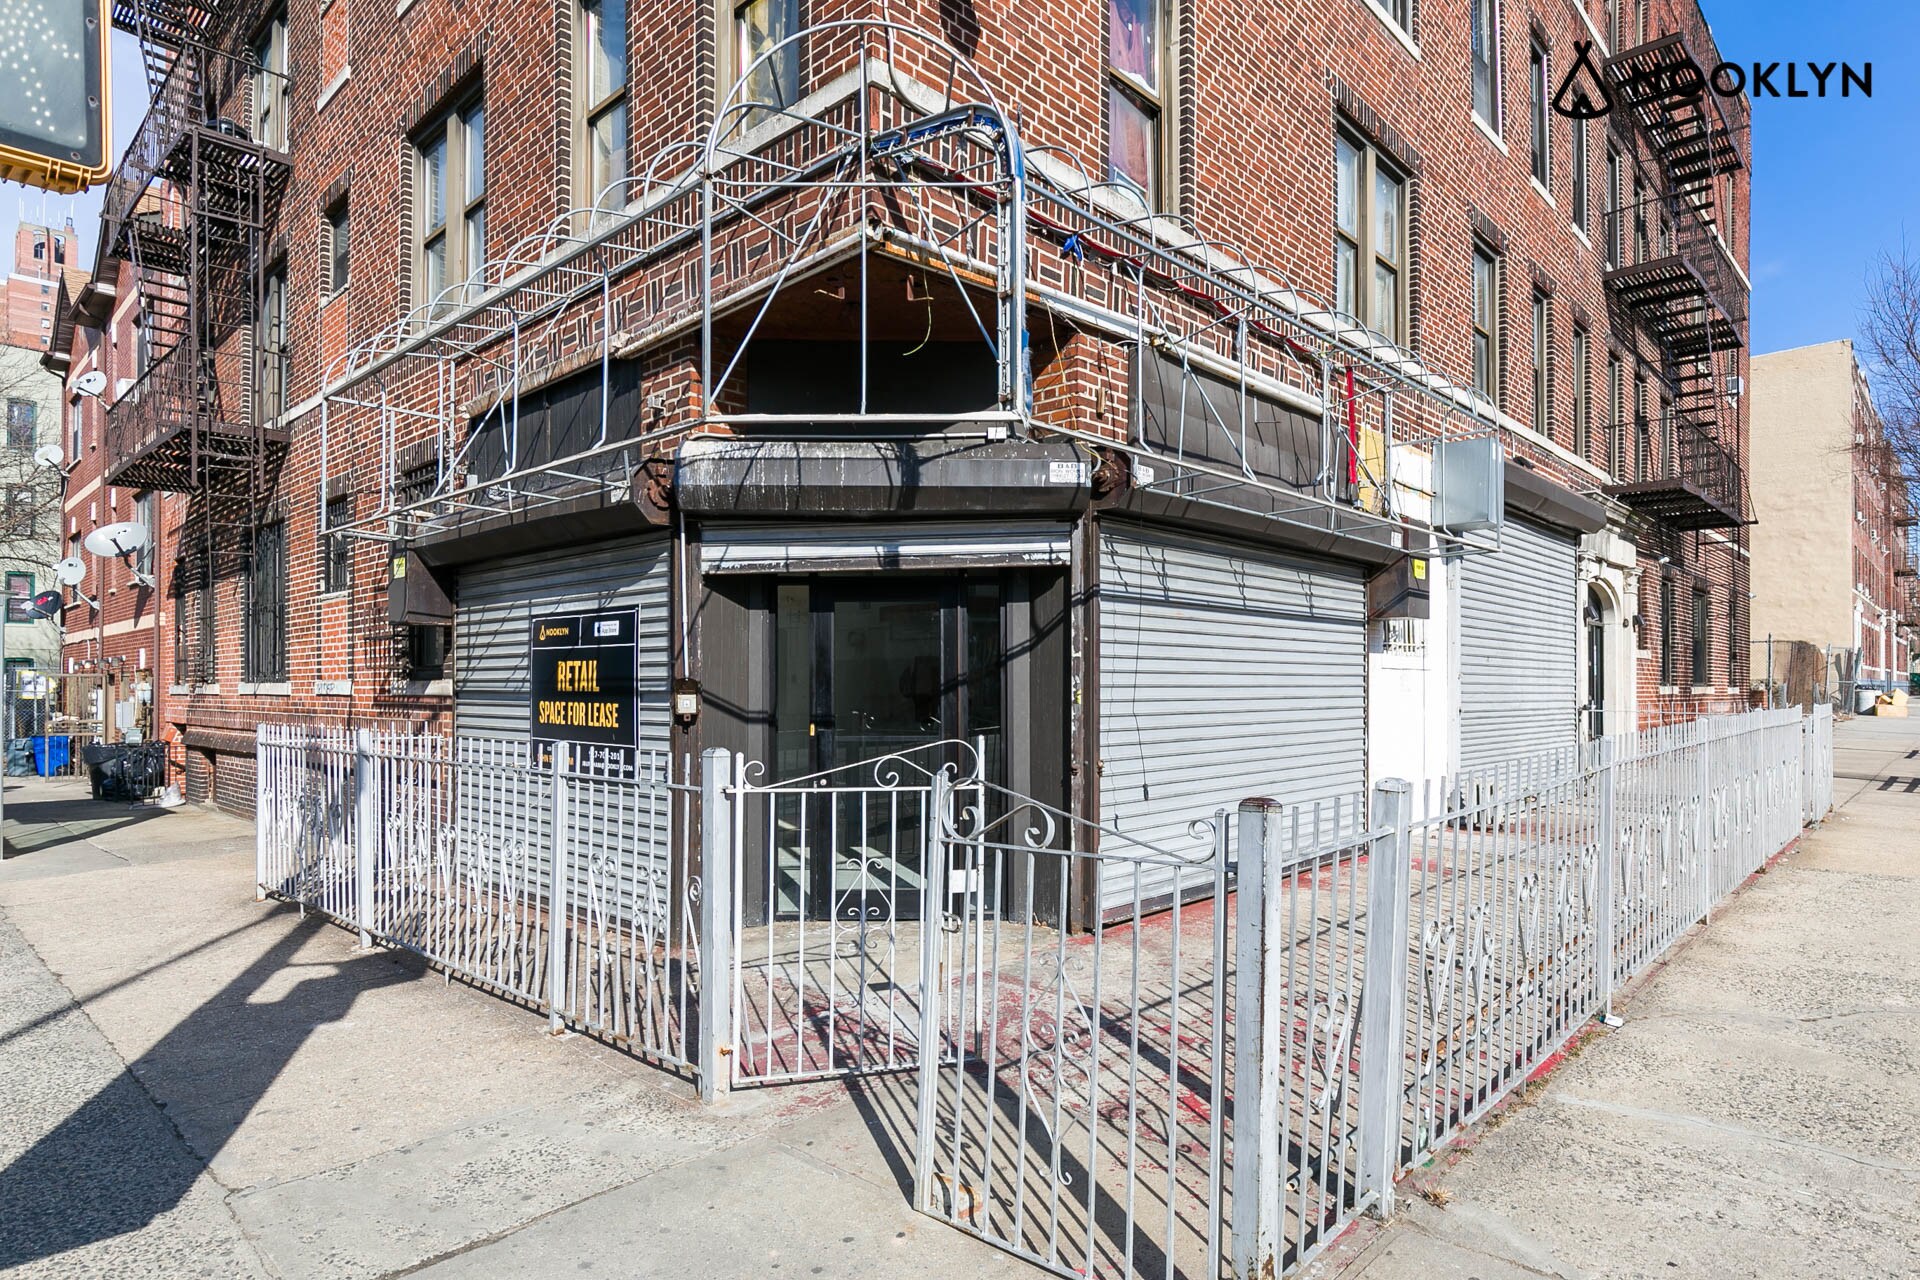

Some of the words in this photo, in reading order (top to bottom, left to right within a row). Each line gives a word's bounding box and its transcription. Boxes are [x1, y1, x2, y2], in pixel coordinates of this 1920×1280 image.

[546, 627, 569, 636] NOOKLYN
[557, 659, 600, 692] RETAIL
[539, 701, 566, 725] SPACE
[568, 701, 585, 727] FOR
[588, 702, 618, 728] LEASE
